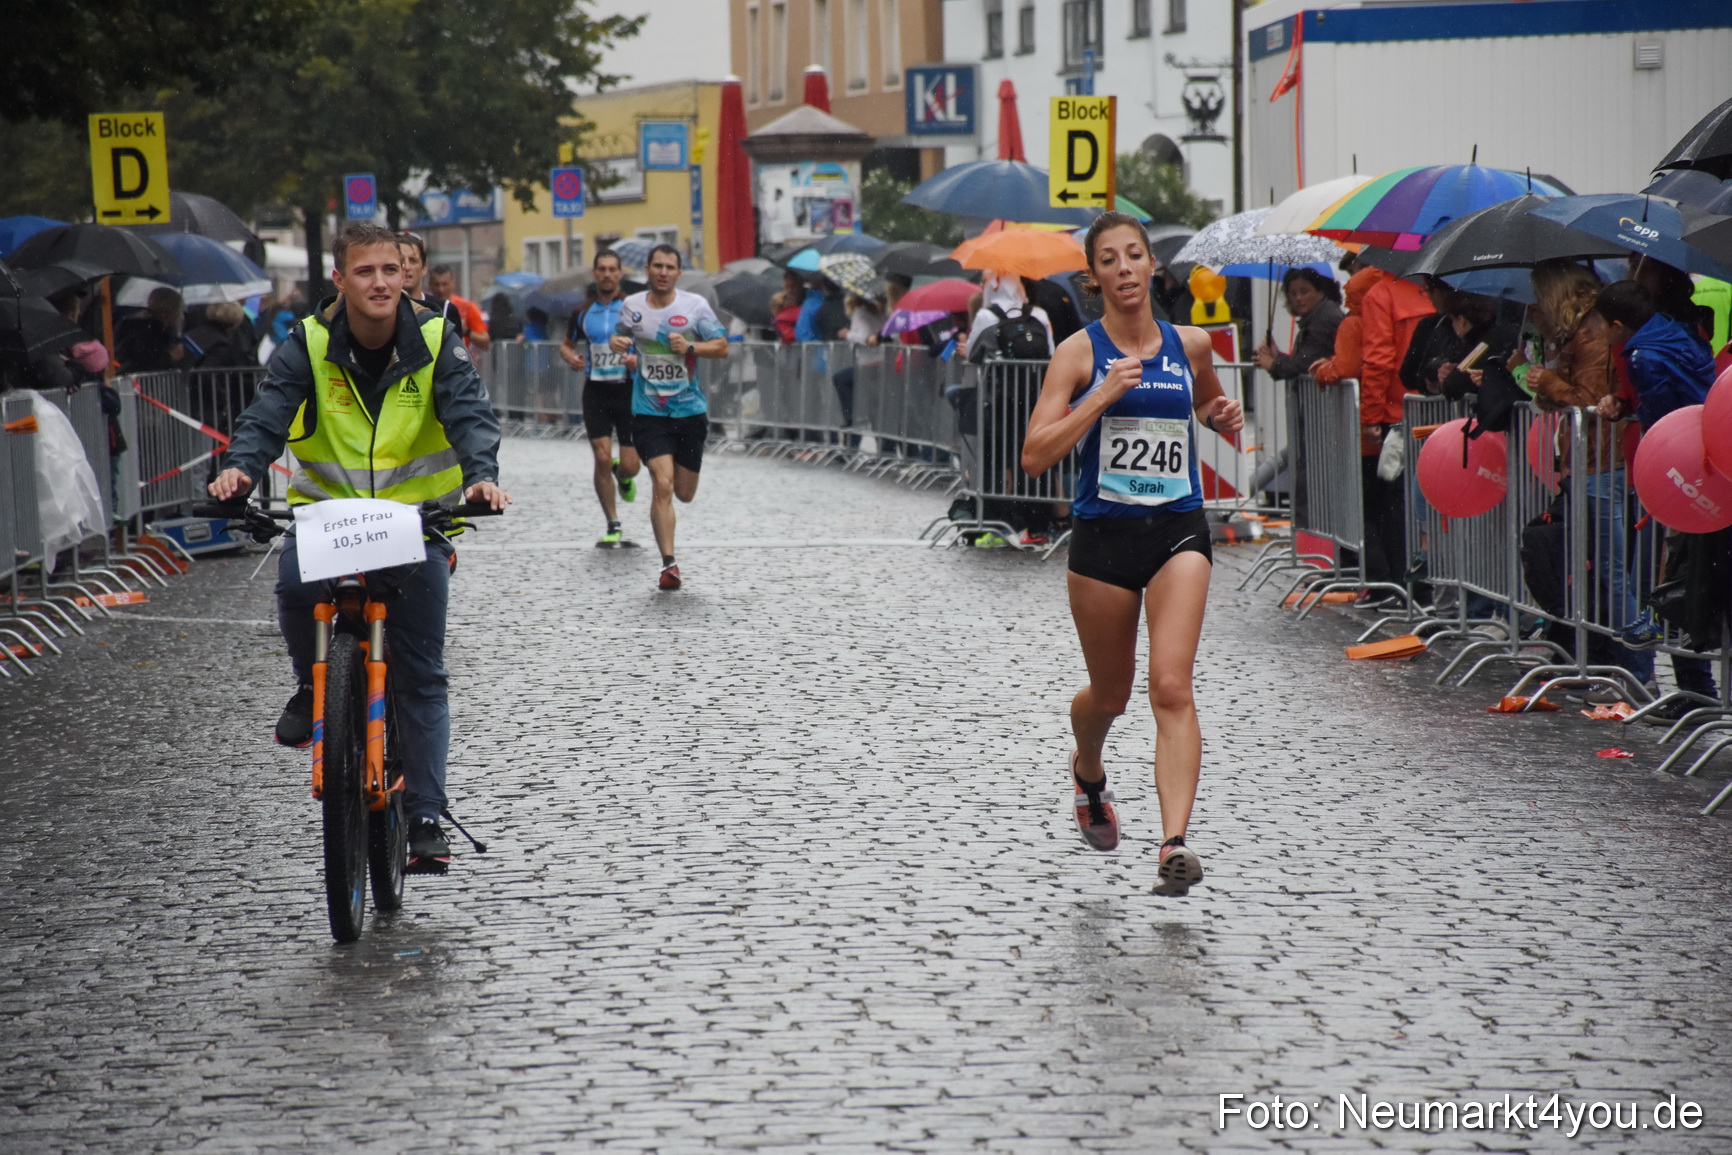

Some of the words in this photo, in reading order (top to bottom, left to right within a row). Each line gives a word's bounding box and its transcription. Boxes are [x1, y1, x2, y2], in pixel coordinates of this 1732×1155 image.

[914, 72, 967, 122] KL
[1058, 101, 1109, 120] Block
[99, 117, 156, 138] Block
[1067, 130, 1099, 182] D
[111, 147, 150, 200] D
[555, 202, 582, 212] TAXI
[1634, 225, 1659, 239] epp
[1472, 253, 1504, 262] Salzburg
[647, 364, 684, 380] 2592
[1162, 356, 1183, 376] LG
[1153, 382, 1183, 391] FINANZ
[1110, 437, 1183, 474] 2246
[1129, 479, 1165, 494] Sarah
[324, 517, 358, 533] Erste
[362, 511, 393, 524] Frau
[333, 533, 362, 549] 10,5
[366, 530, 388, 543] km
